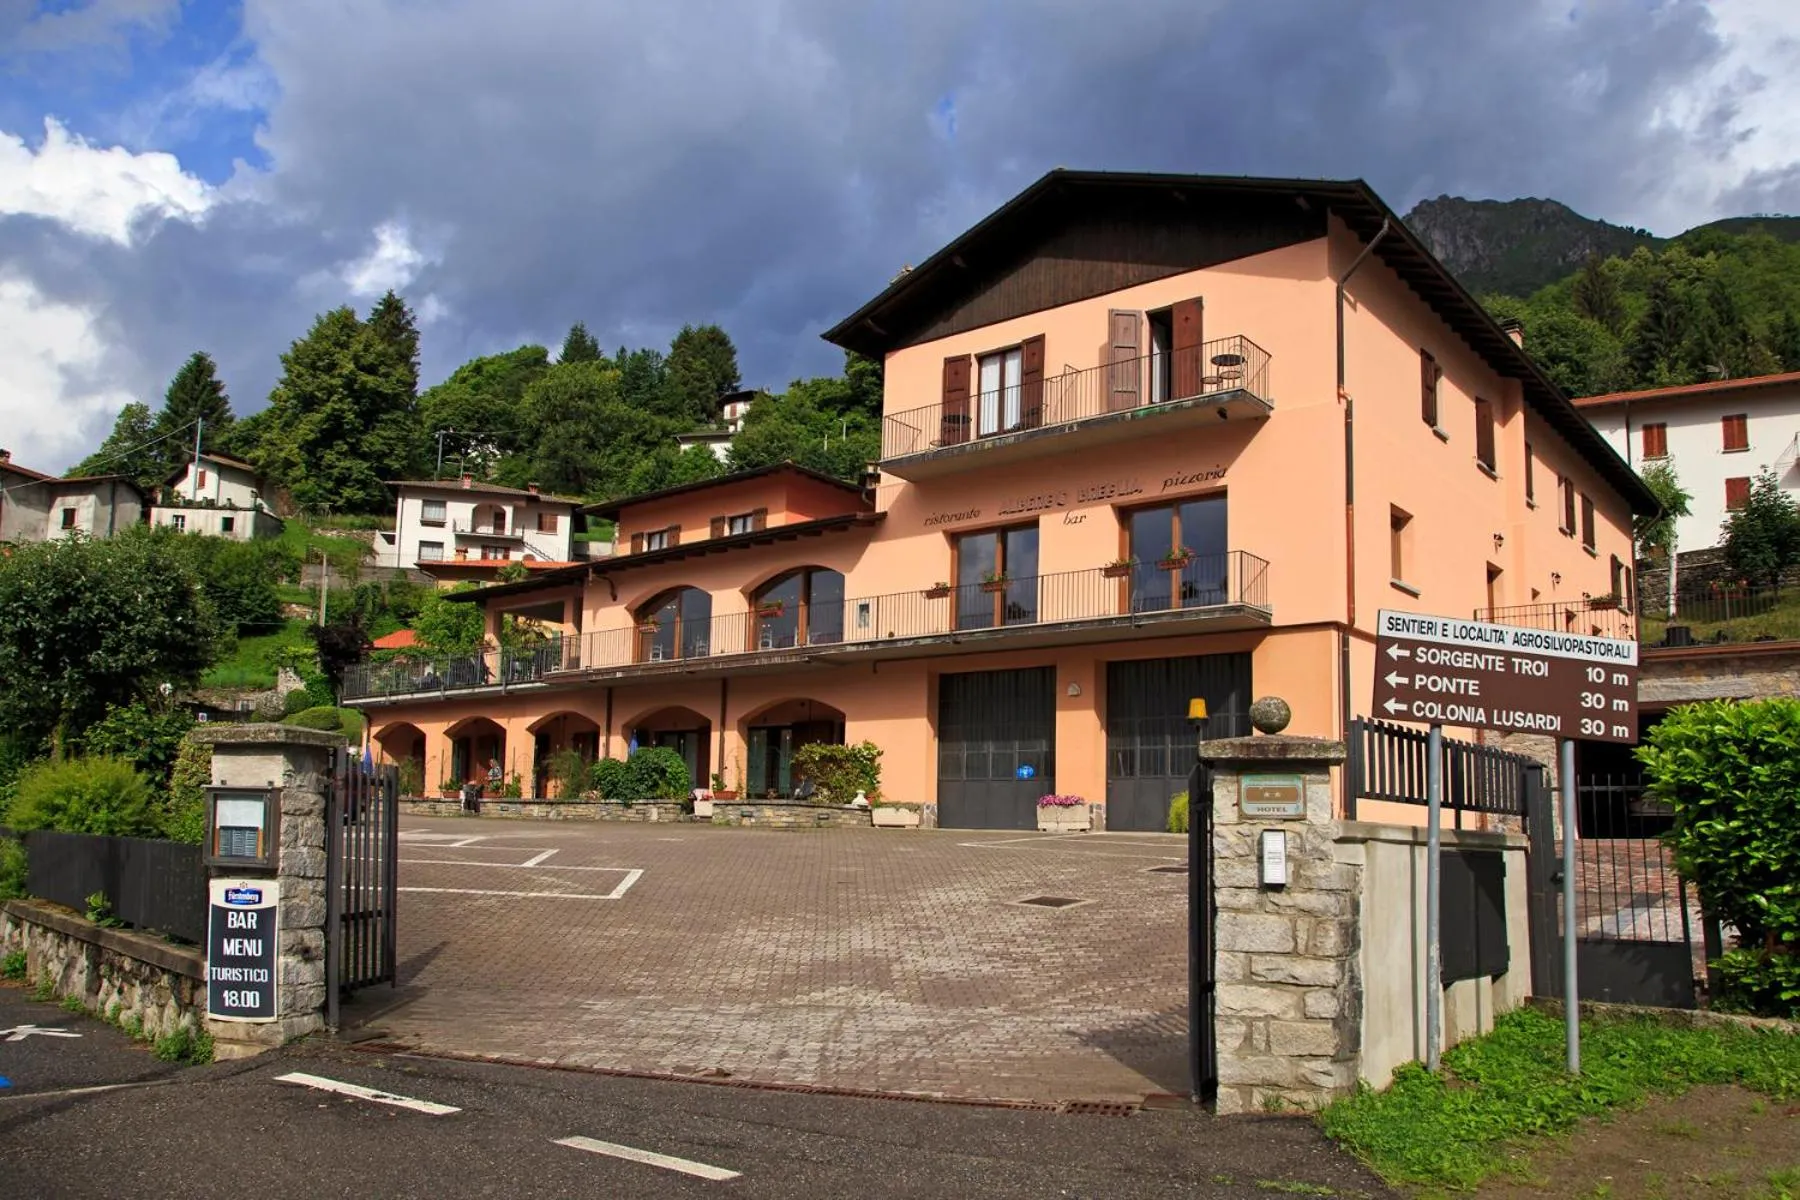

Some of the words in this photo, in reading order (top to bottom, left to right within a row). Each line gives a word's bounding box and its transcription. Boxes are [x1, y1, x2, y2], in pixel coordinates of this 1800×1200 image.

[1161, 464, 1228, 492] pizzeria
[923, 509, 981, 526] ristorante
[1063, 510, 1087, 525] bar
[1387, 616, 1437, 636] SENTIERI
[1442, 623, 1448, 637] E
[1513, 632, 1631, 659] AGROSILVOPASTORALI
[1415, 647, 1505, 672] SORGENTE
[1512, 658, 1549, 677] TROI
[1585, 667, 1605, 684] 10
[1612, 673, 1629, 686] m
[1414, 675, 1480, 696] PONTE
[1580, 692, 1605, 710] 30
[1612, 699, 1629, 712] m
[1412, 700, 1487, 724] COLONIA
[1493, 712, 1561, 731] LUSARDI
[1580, 718, 1605, 736] 30
[1612, 725, 1629, 738] m
[227, 911, 257, 929] BAR
[223, 938, 262, 956] MENU
[211, 966, 268, 982] TURISTICO
[222, 990, 260, 1008] 18.00
